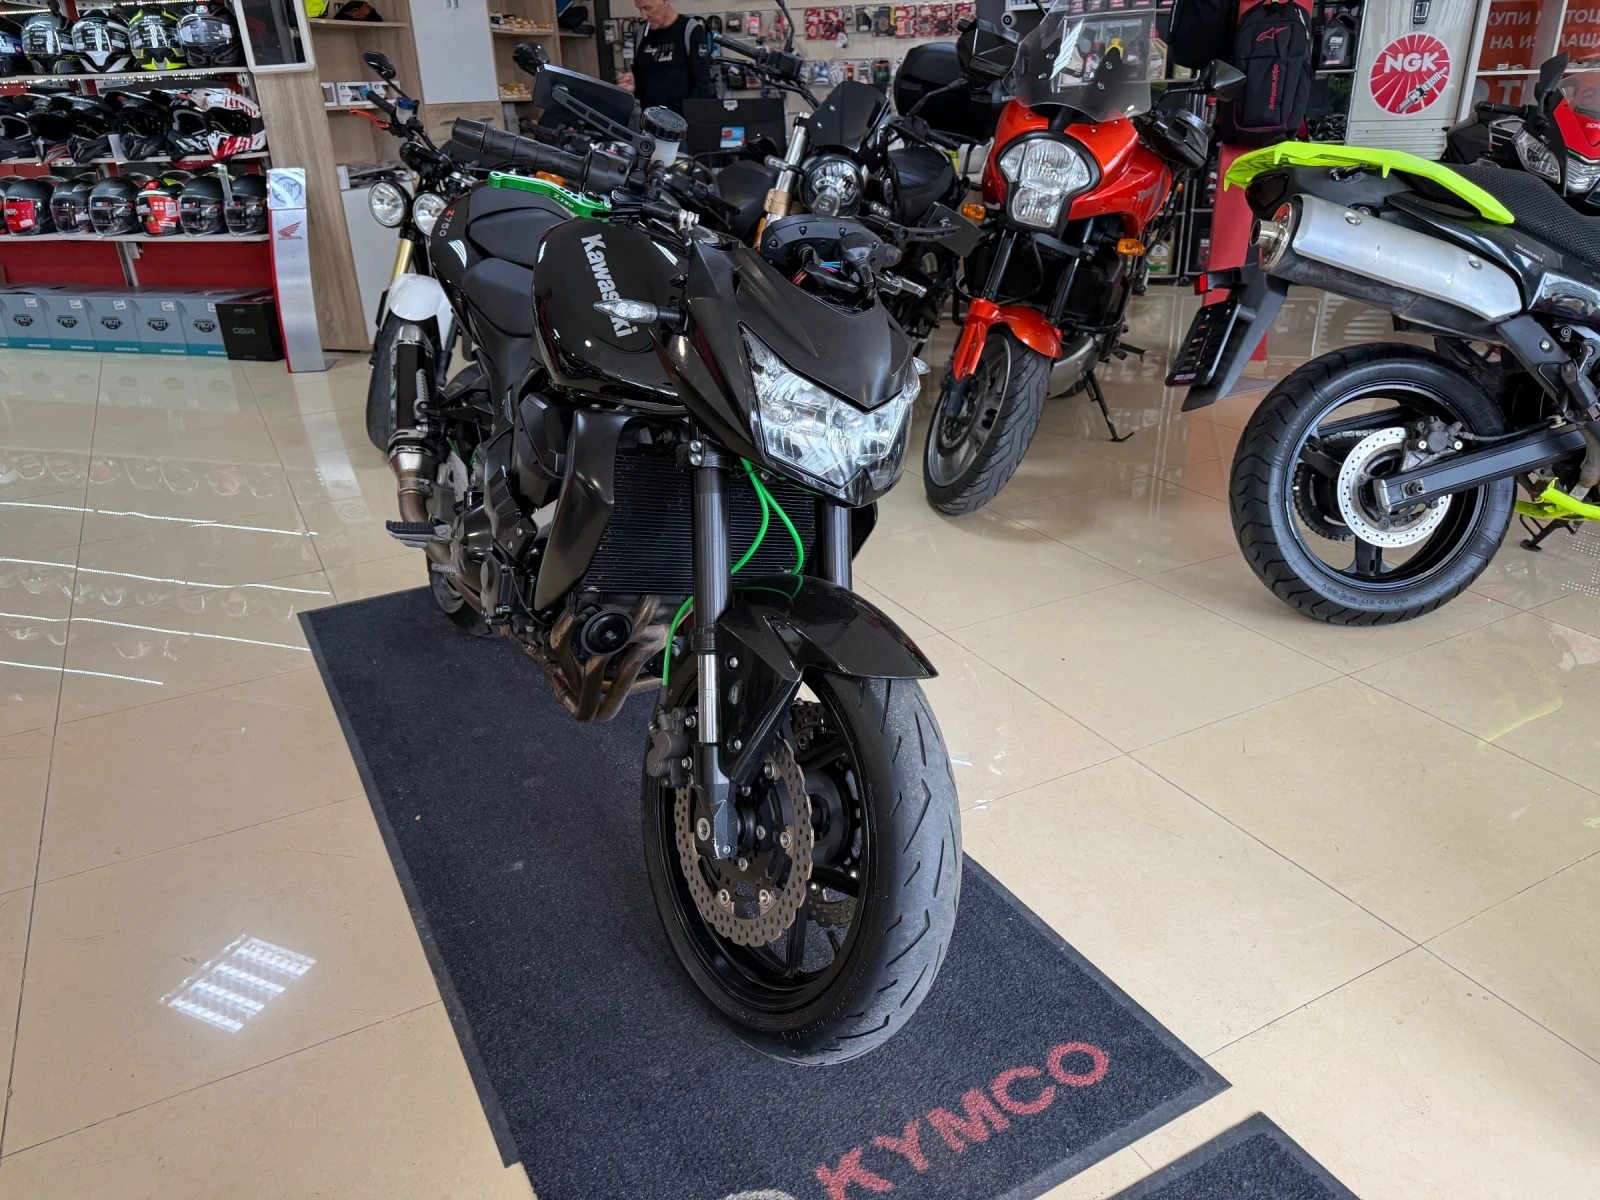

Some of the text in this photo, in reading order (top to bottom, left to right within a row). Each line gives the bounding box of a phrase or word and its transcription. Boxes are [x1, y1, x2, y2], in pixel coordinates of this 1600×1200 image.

[1489, 36, 1514, 49] НА
[1383, 51, 1440, 73] NGK
[1515, 243, 1543, 262] SUZUKI
[581, 233, 639, 338] Kawaski
[814, 1040, 1110, 1200] KYMCO
